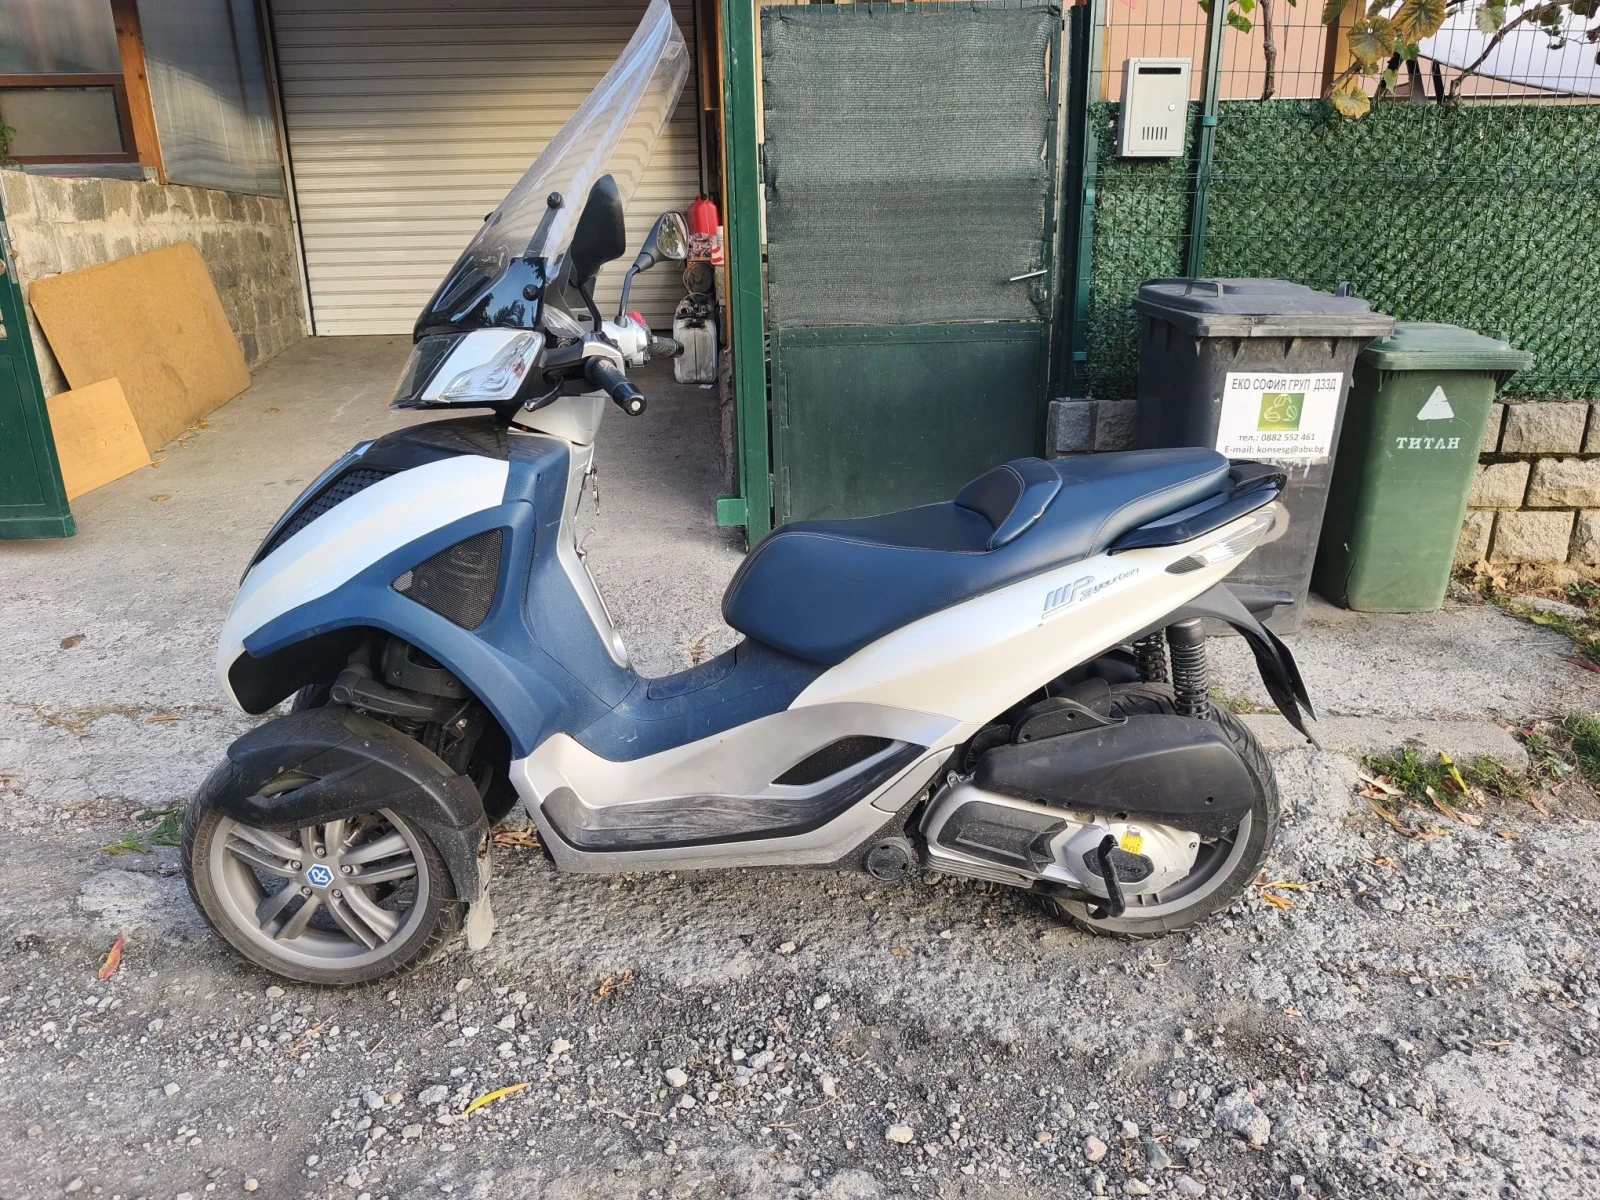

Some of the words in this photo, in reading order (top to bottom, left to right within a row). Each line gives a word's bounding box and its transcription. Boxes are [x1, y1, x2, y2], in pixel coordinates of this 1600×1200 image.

[1231, 378, 1251, 390] ЕКО
[1253, 378, 1287, 391] СОФИЯ
[1288, 379, 1311, 391] ГРУП
[1313, 378, 1337, 392] ДЗЗД
[1260, 433, 1282, 442] 0882
[1284, 433, 1299, 442] 552
[1301, 433, 1316, 441] 461
[1395, 436, 1461, 450] ТИТАН
[1224, 445, 1255, 454] E-mail:
[1256, 444, 1325, 455] konsesg@abv.bg
